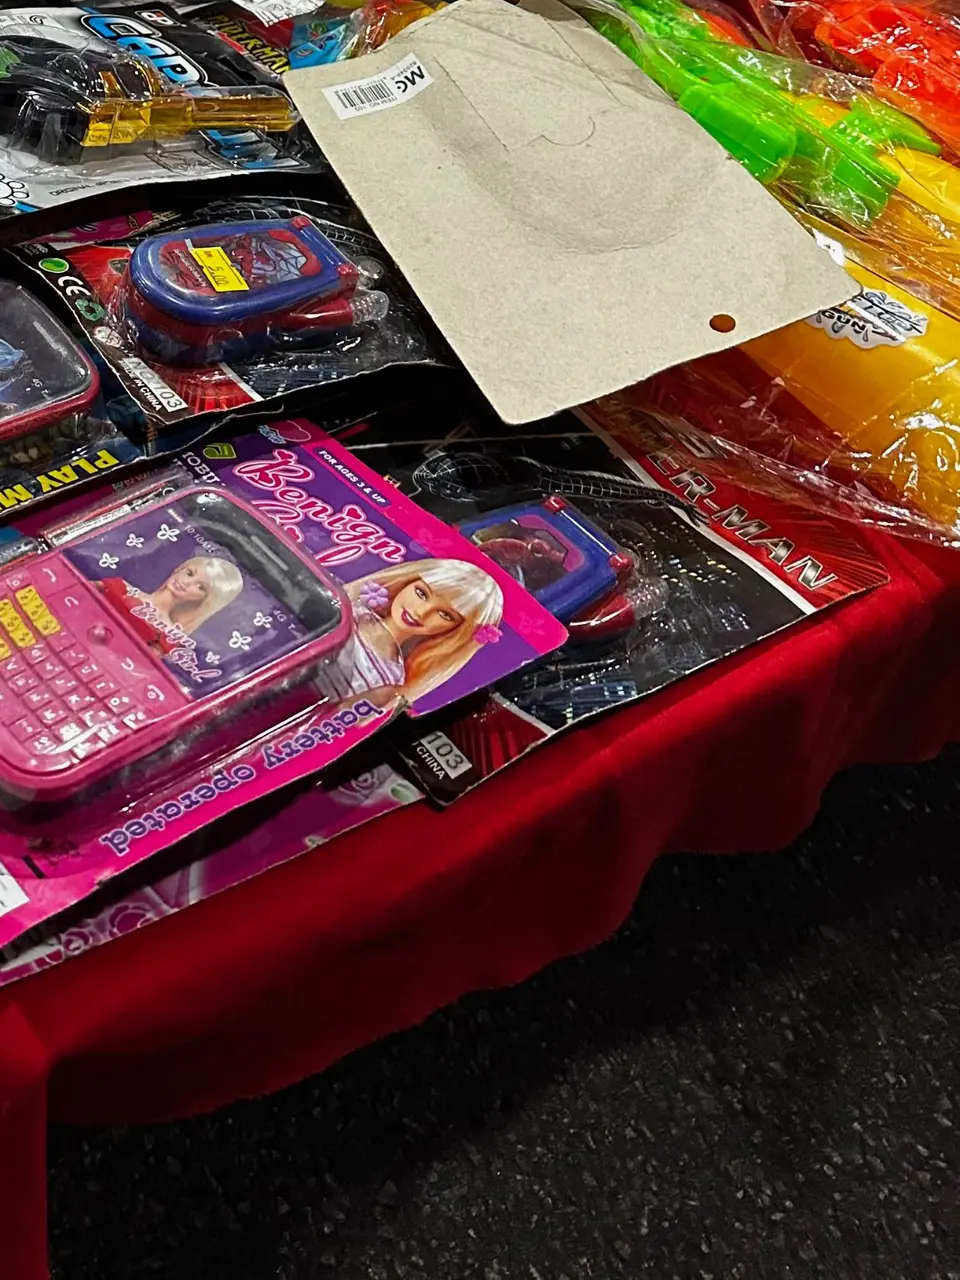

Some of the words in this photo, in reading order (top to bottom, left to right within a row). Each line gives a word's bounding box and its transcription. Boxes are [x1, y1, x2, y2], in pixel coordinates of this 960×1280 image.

[395, 66, 425, 93] MC
[57, 275, 91, 296] CE
[820, 308, 867, 333] GUN
[140, 385, 163, 412] CHINA
[37, 449, 120, 493] PLAY
[318, 449, 337, 465] FOR
[334, 463, 359, 483] AGES
[357, 479, 365, 488] 3
[363, 485, 373, 496] &
[372, 492, 387, 504] UP
[233, 449, 407, 563] Benign
[130, 600, 197, 650] Benign
[261, 699, 386, 769] battery
[427, 733, 464, 769] 103
[416, 746, 446, 780] CHINA
[100, 765, 255, 856] operated
